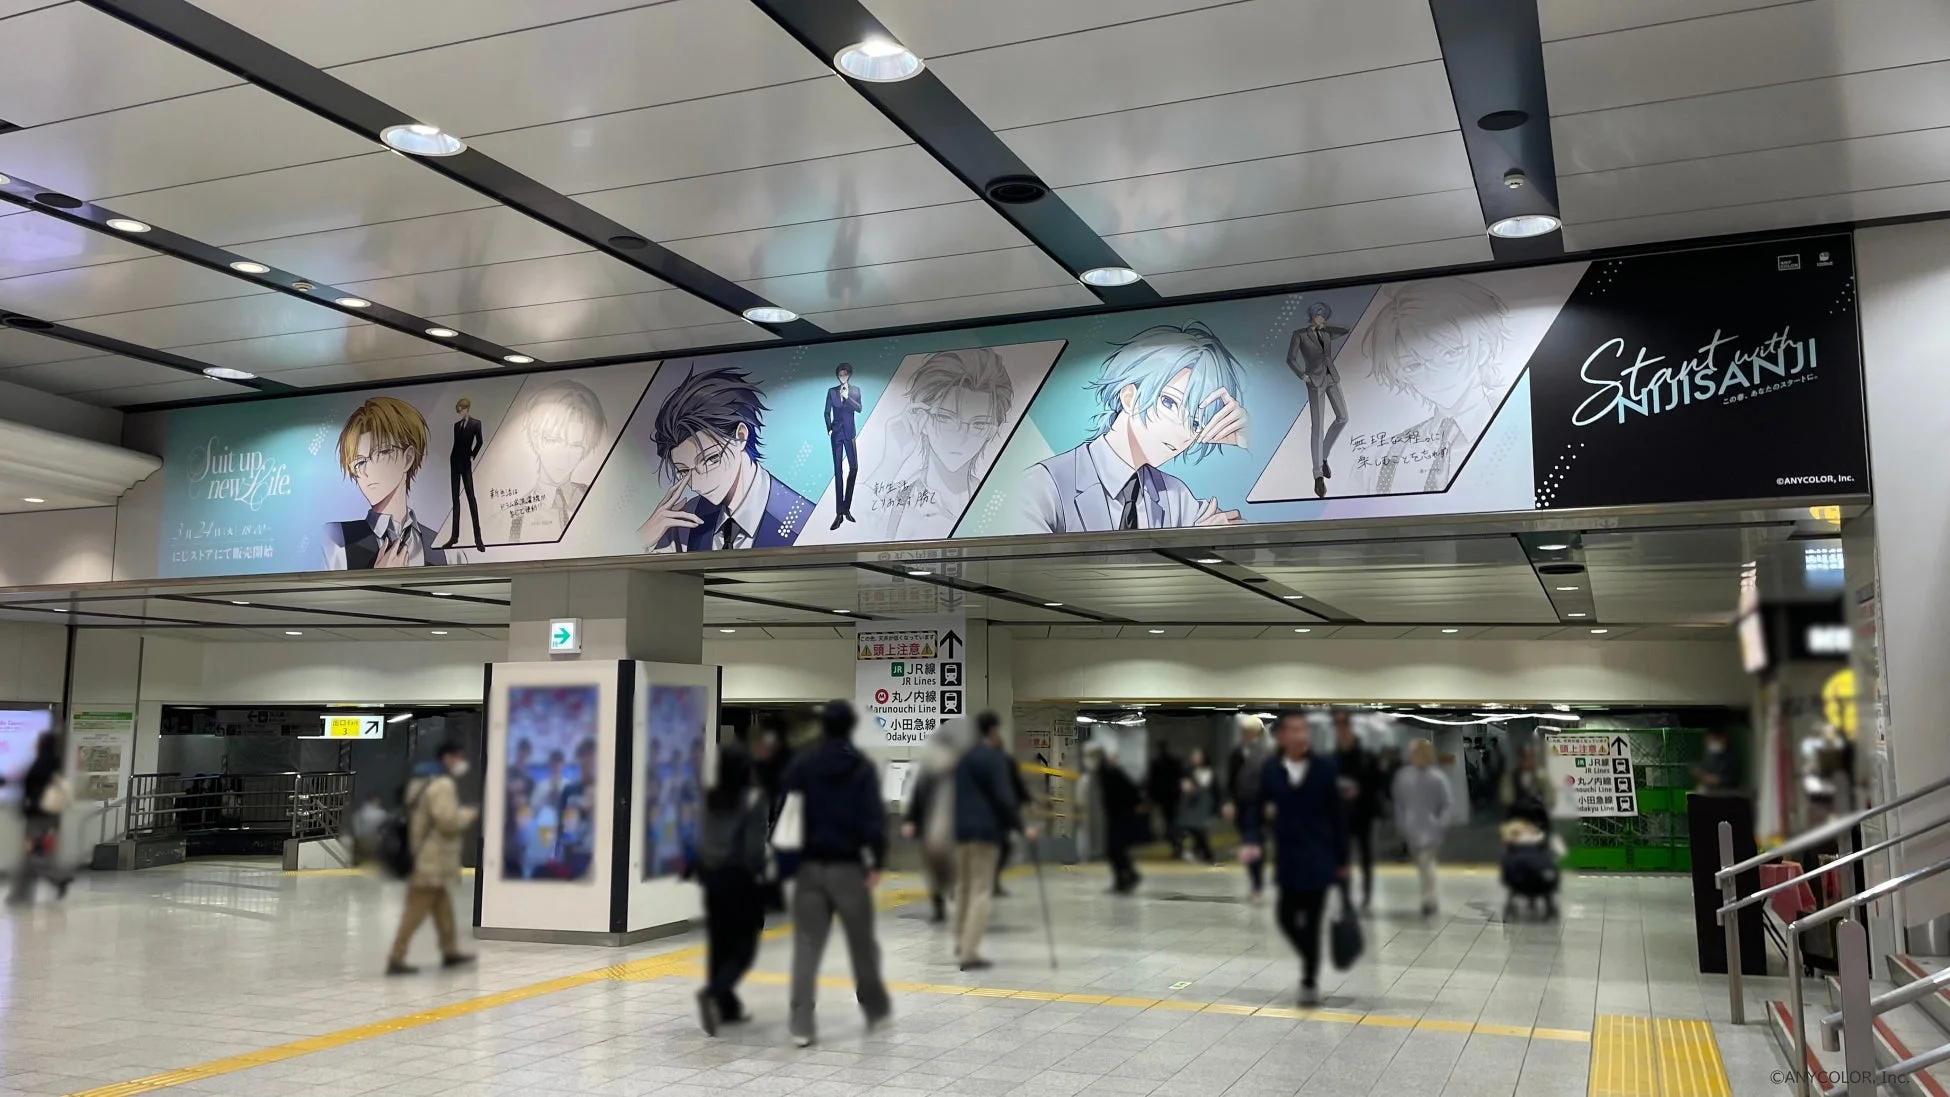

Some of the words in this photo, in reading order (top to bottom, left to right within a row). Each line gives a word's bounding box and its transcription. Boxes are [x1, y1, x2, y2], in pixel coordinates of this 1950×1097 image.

[1571, 328, 1739, 427] Start
[1734, 325, 1799, 365] with
[1616, 337, 1818, 425] NIJISANJI
[1776, 475, 1837, 486] ©ANYCOLOR,
[1838, 474, 1855, 483] Inc.
[207, 477, 242, 500] new
[873, 643, 921, 657] 頭上注意
[907, 663, 936, 676] JR線
[902, 677, 912, 686] JR
[914, 677, 936, 686] Lines
[891, 691, 937, 703] 丸ノ内線
[918, 704, 937, 714] Line
[890, 718, 936, 731] 小田急線
[342, 727, 348, 736] 3
[1577, 805, 1599, 813] dakyu
